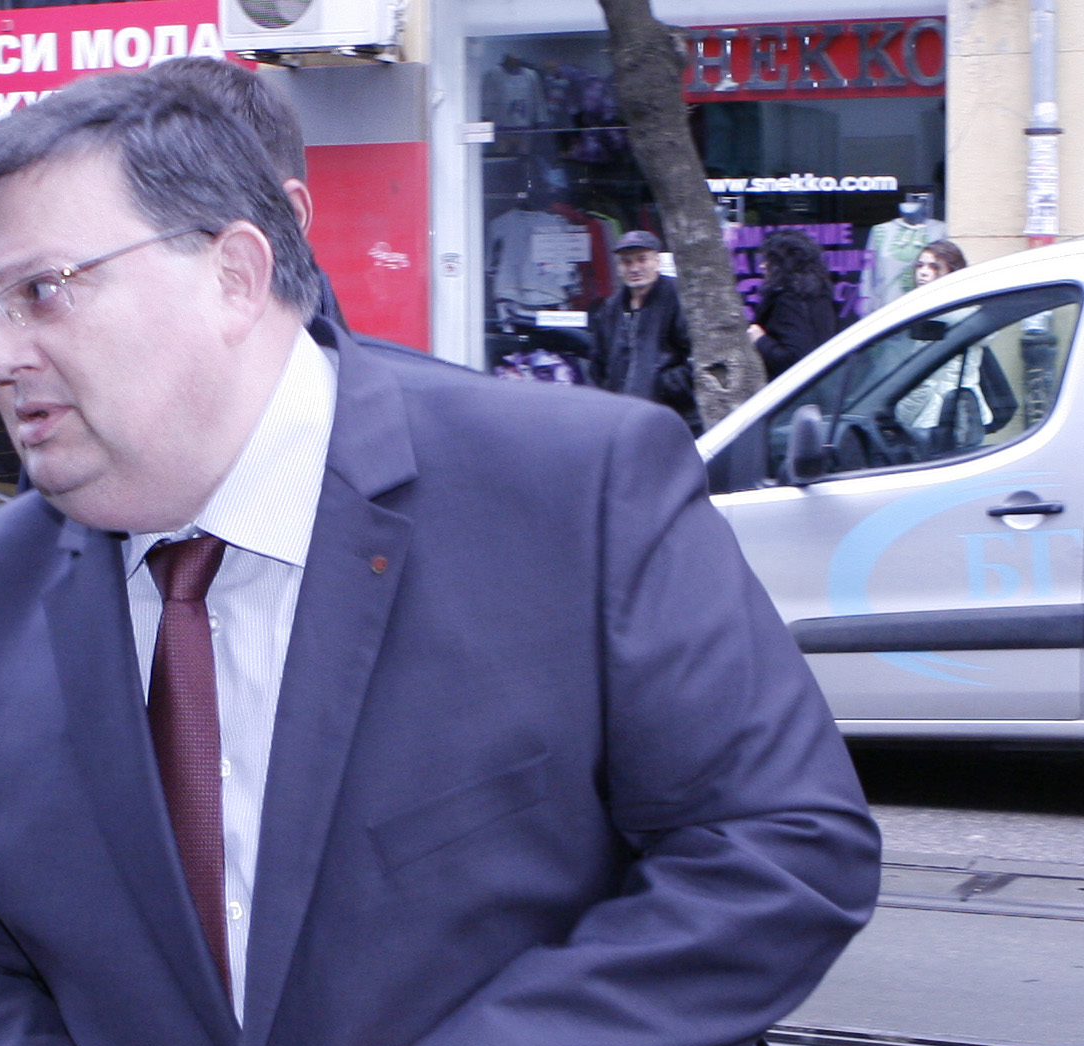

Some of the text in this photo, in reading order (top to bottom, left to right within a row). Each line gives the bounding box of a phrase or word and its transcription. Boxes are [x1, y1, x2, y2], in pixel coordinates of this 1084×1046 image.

[71, 22, 227, 70] МОДА
[687, 19, 946, 92] НЕККО
[704, 172, 898, 194] ww.snekko.com
